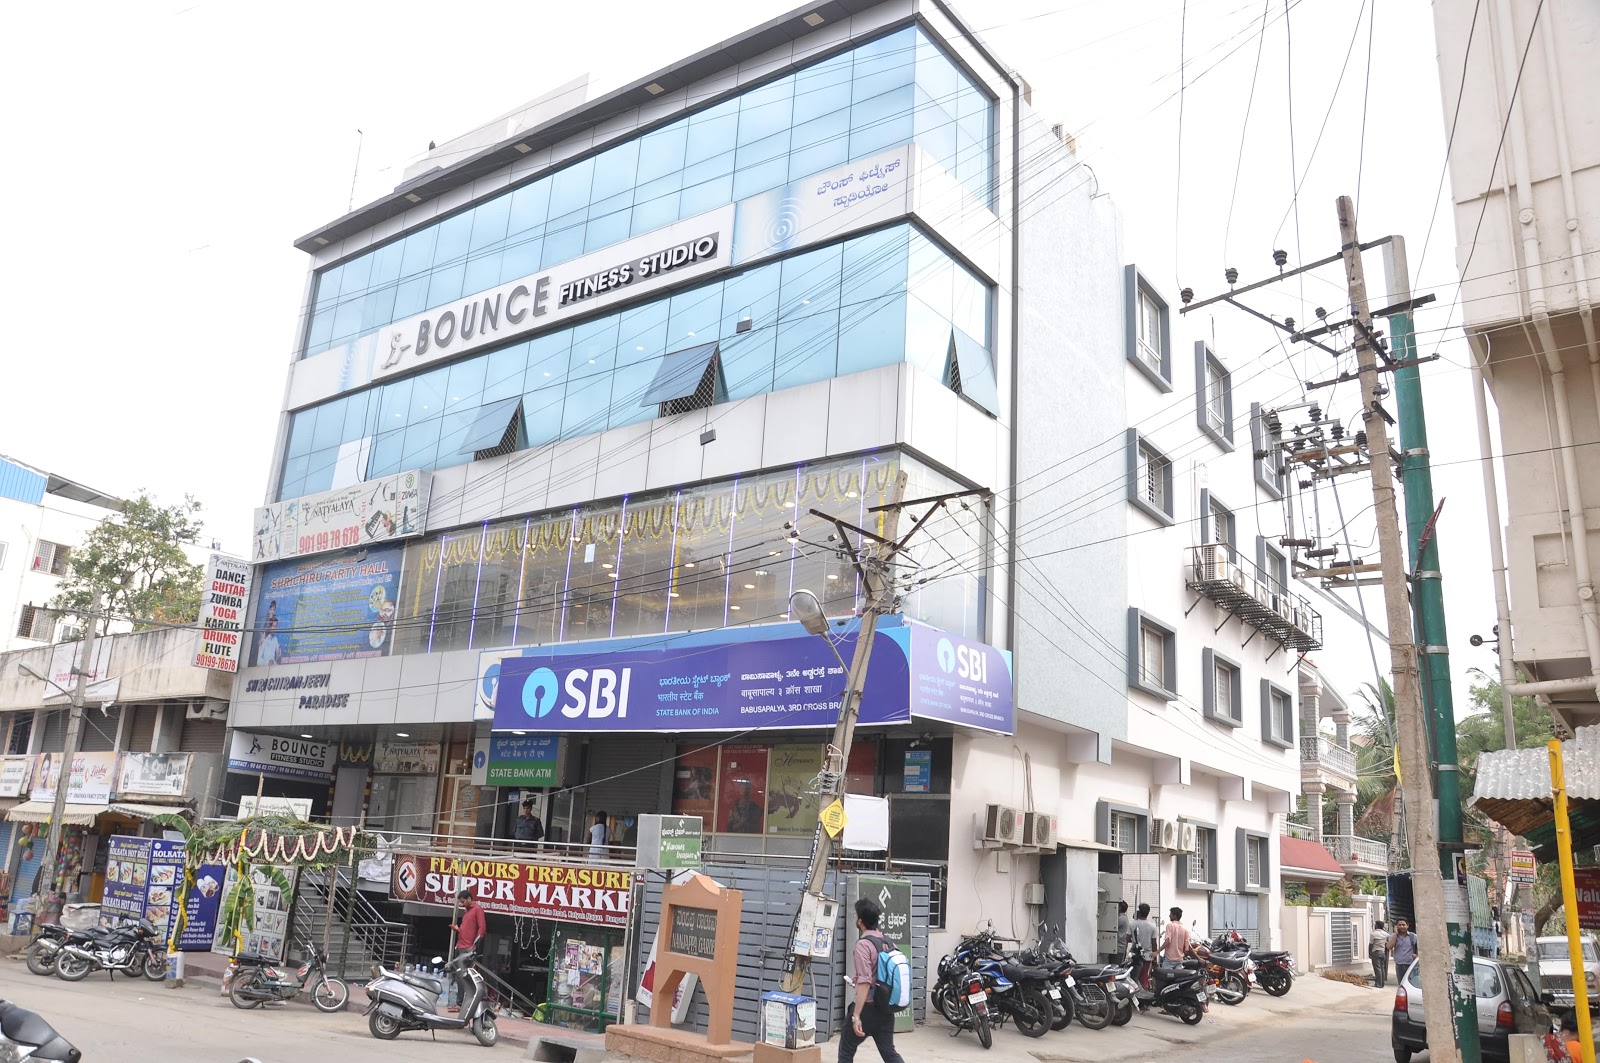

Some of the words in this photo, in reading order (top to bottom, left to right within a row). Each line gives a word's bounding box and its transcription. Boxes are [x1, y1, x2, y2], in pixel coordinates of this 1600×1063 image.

[415, 276, 551, 355] BOUNCE
[559, 264, 632, 305] FITNESS
[638, 236, 715, 278] STUDIO
[313, 499, 360, 523] NATYALAYA
[299, 534, 315, 554] 901
[316, 531, 328, 551] 99
[330, 528, 340, 548] 78
[343, 526, 360, 546] 678
[215, 569, 246, 584] DANCE
[271, 573, 323, 589] SHRICHIRU
[325, 566, 358, 581] PARTY
[359, 561, 389, 576] HALL
[212, 581, 246, 596] GUITAR
[210, 593, 242, 608] ZUMBA
[212, 605, 237, 620] YOGA
[205, 617, 240, 632] KARATE
[203, 629, 237, 645] DRUMS
[205, 642, 231, 656] FLUTE
[196, 654, 236, 671] 90199-78678
[957, 644, 986, 684] SBI
[246, 674, 331, 692] SHRICHIRANJEEVI
[804, 685, 823, 694] शाखा
[561, 668, 631, 719] SBI
[657, 690, 678, 702] भारतीय
[679, 690, 693, 701] स्टेट
[694, 690, 704, 701] बैंक
[299, 694, 349, 709] PARADISE
[741, 705, 787, 714] BABUSAPALYA,
[788, 703, 802, 711] 3RD
[803, 702, 827, 711] CROSS
[656, 709, 674, 717] STATE
[675, 708, 692, 716] BANK
[692, 708, 701, 716] OF
[701, 707, 719, 715] INDIA
[272, 739, 326, 758] BOUNCE
[230, 759, 247, 767] CONTACT
[272, 753, 297, 763] FITNESS
[299, 758, 323, 767] STUDIO
[490, 768, 512, 778] STATE
[513, 768, 535, 778] BANK
[535, 768, 552, 778] ATM
[109, 847, 128, 857] KOLKATA
[137, 851, 149, 859] ROLL
[153, 850, 186, 858] KOLKATA
[430, 857, 520, 880] FLAVOURS
[526, 866, 631, 889] TREASURE
[425, 873, 515, 901] SUPER
[525, 883, 630, 912] MARKE
[491, 902, 508, 911] Garden,
